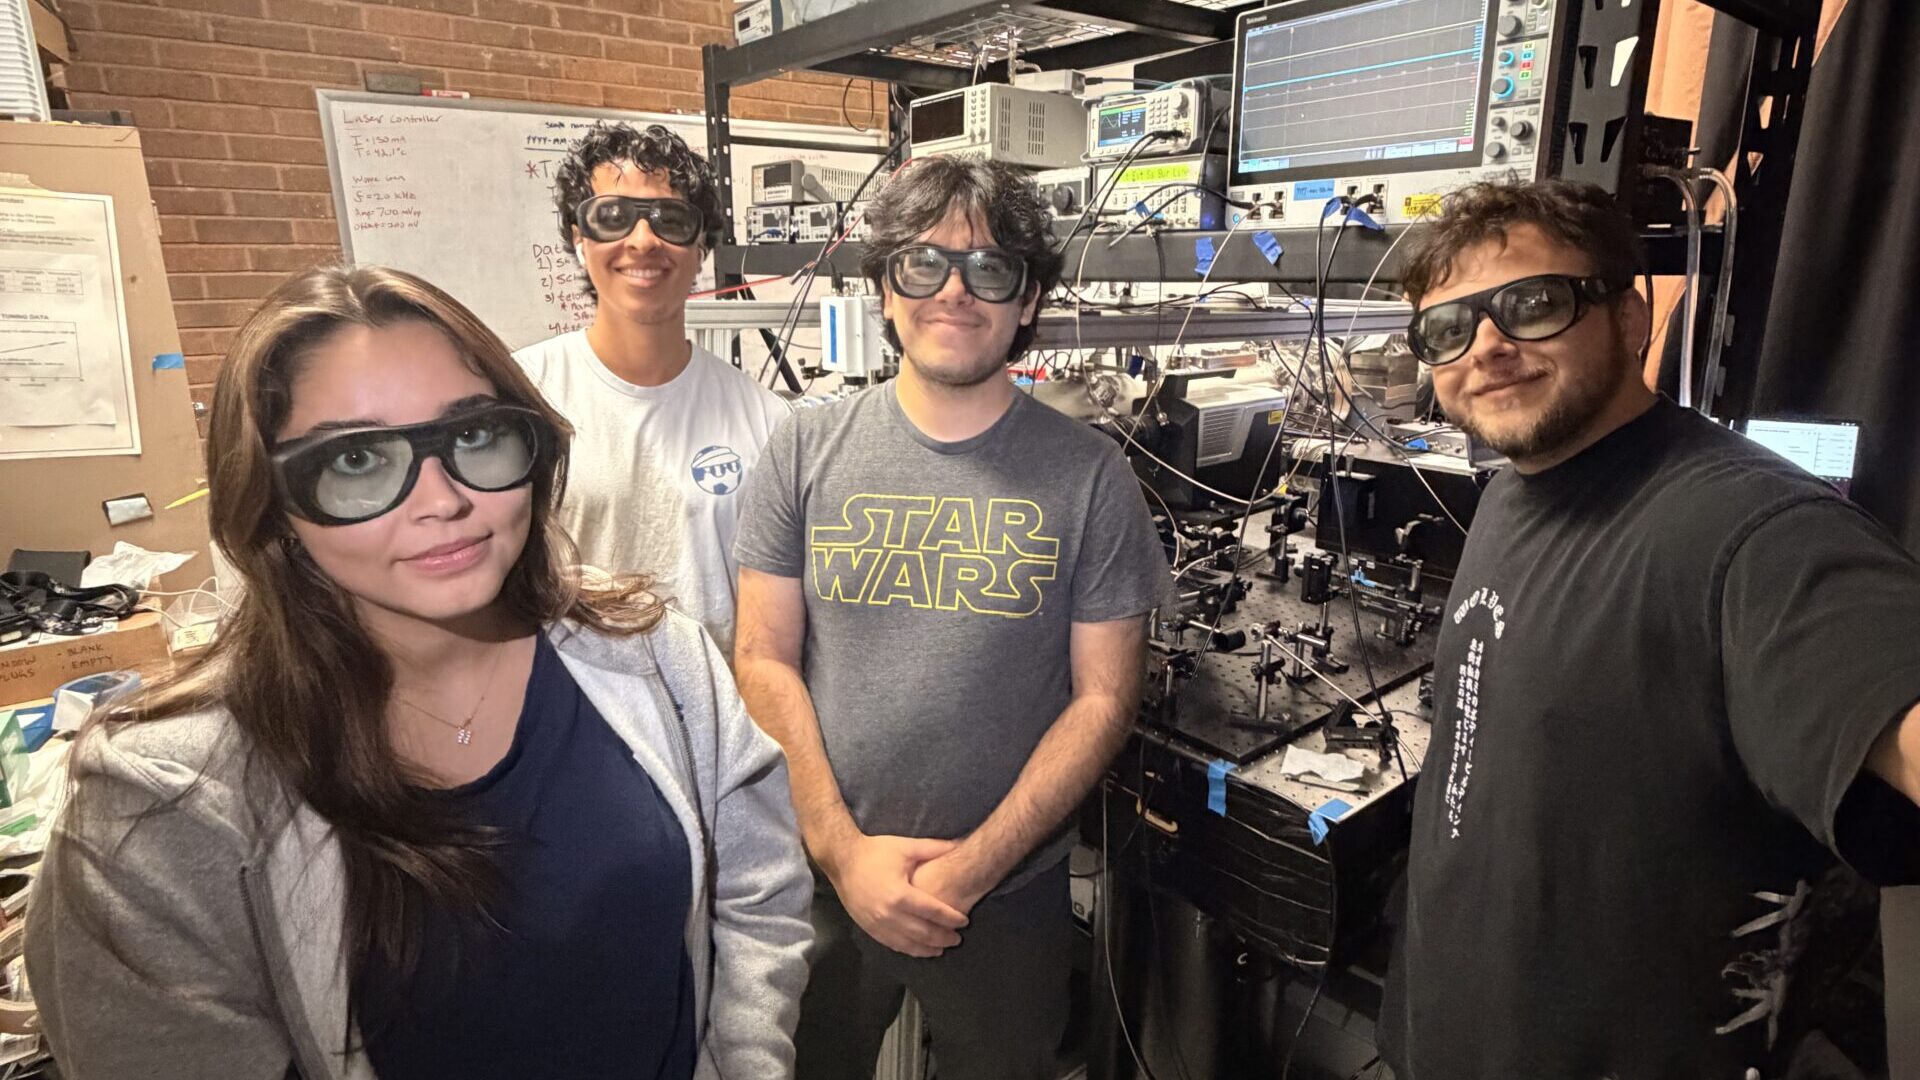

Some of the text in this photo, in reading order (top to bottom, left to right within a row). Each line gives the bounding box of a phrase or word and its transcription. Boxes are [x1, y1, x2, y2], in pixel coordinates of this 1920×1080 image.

[532, 243, 563, 259] Dat
[811, 493, 1059, 559] STAR
[811, 547, 1057, 617] WARS
[66, 643, 105, 657] BLANK
[0, 656, 37, 669] NDOW
[71, 655, 114, 669] EMPTY
